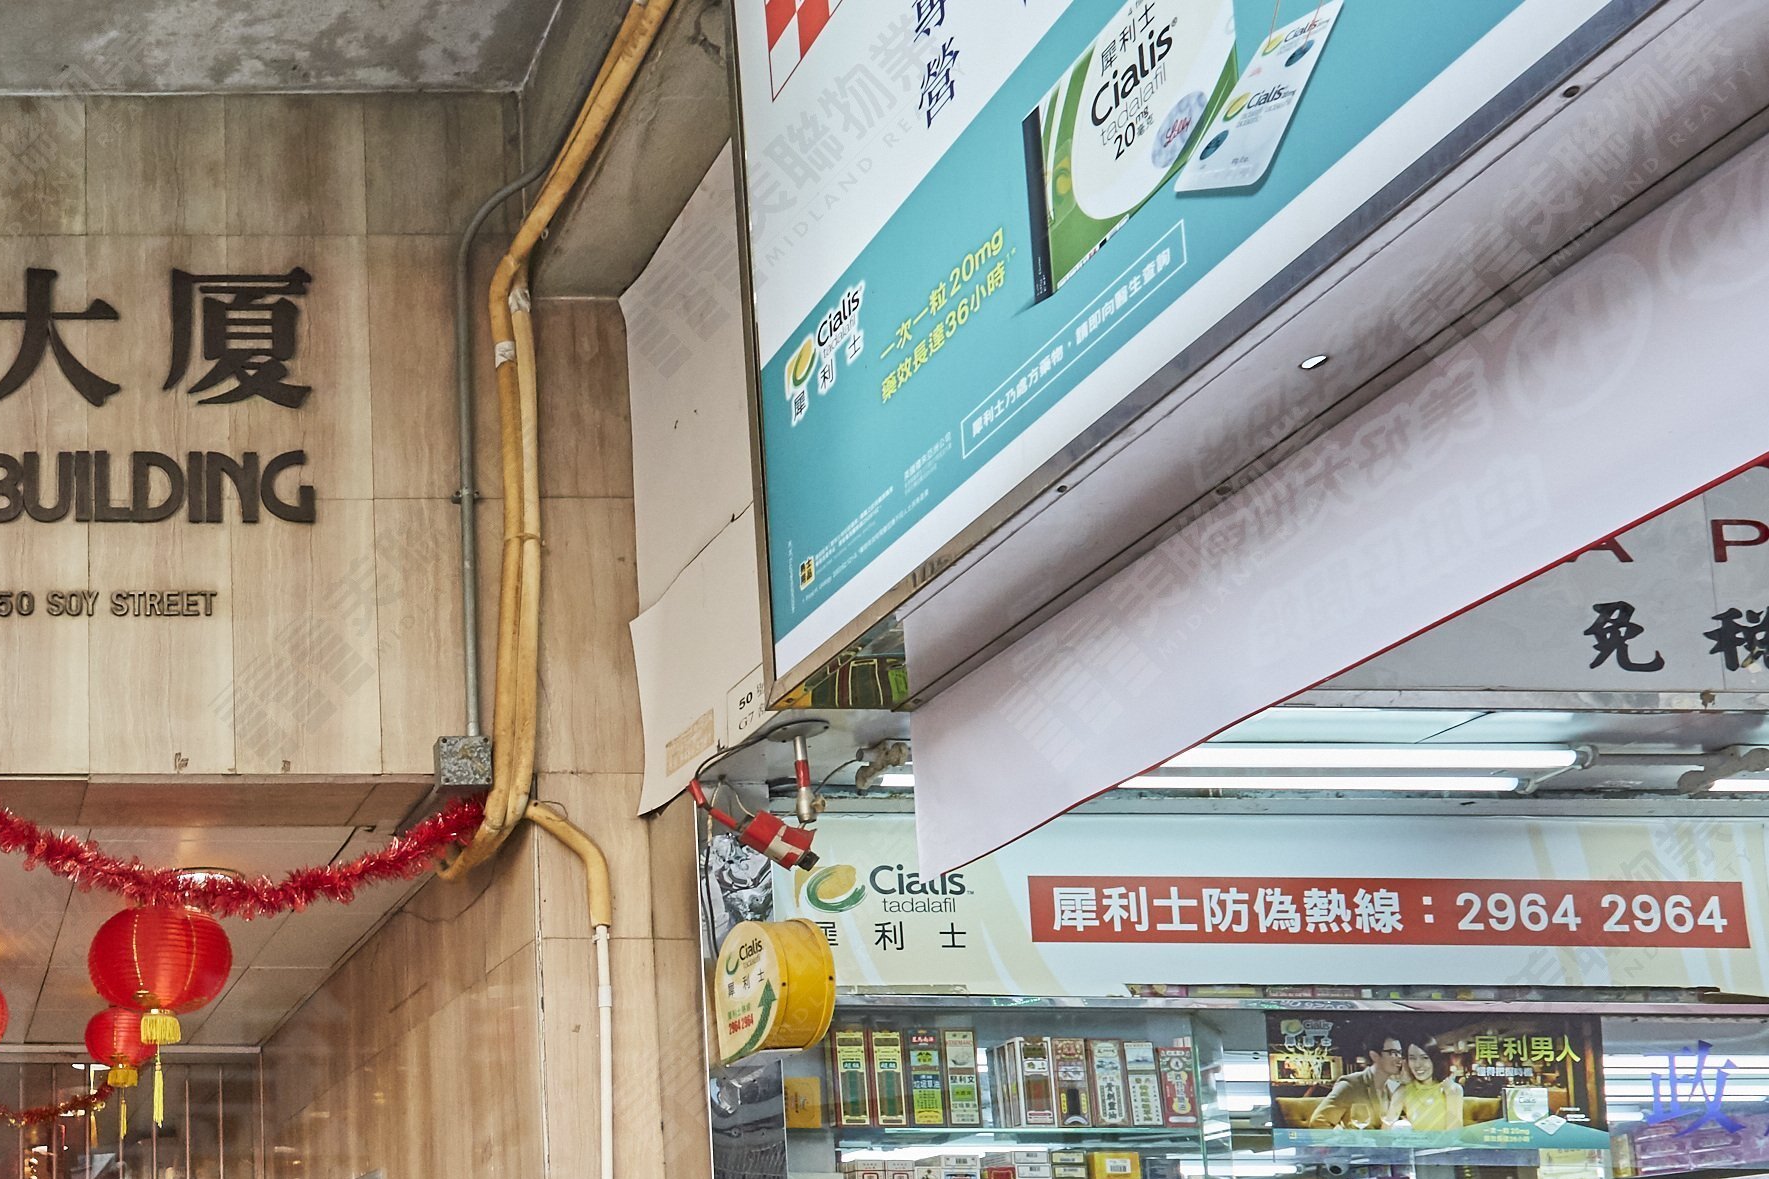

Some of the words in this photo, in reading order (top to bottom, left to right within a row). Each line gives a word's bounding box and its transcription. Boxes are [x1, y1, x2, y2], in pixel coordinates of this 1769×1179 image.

[1101, 2, 1156, 77] 犀利士
[1091, 24, 1173, 126] Cialis
[1100, 62, 1167, 146] tadalafil
[818, 287, 861, 347] Cialis
[46, 591, 98, 616] SOY
[110, 590, 218, 617] STREET
[738, 691, 753, 710] 50
[882, 897, 956, 914] tadalafil
[1455, 892, 1582, 933] 2964
[1601, 893, 1728, 934] 2964
[739, 938, 763, 961] Cialis
[1474, 1034, 1581, 1064] 犀利男人
